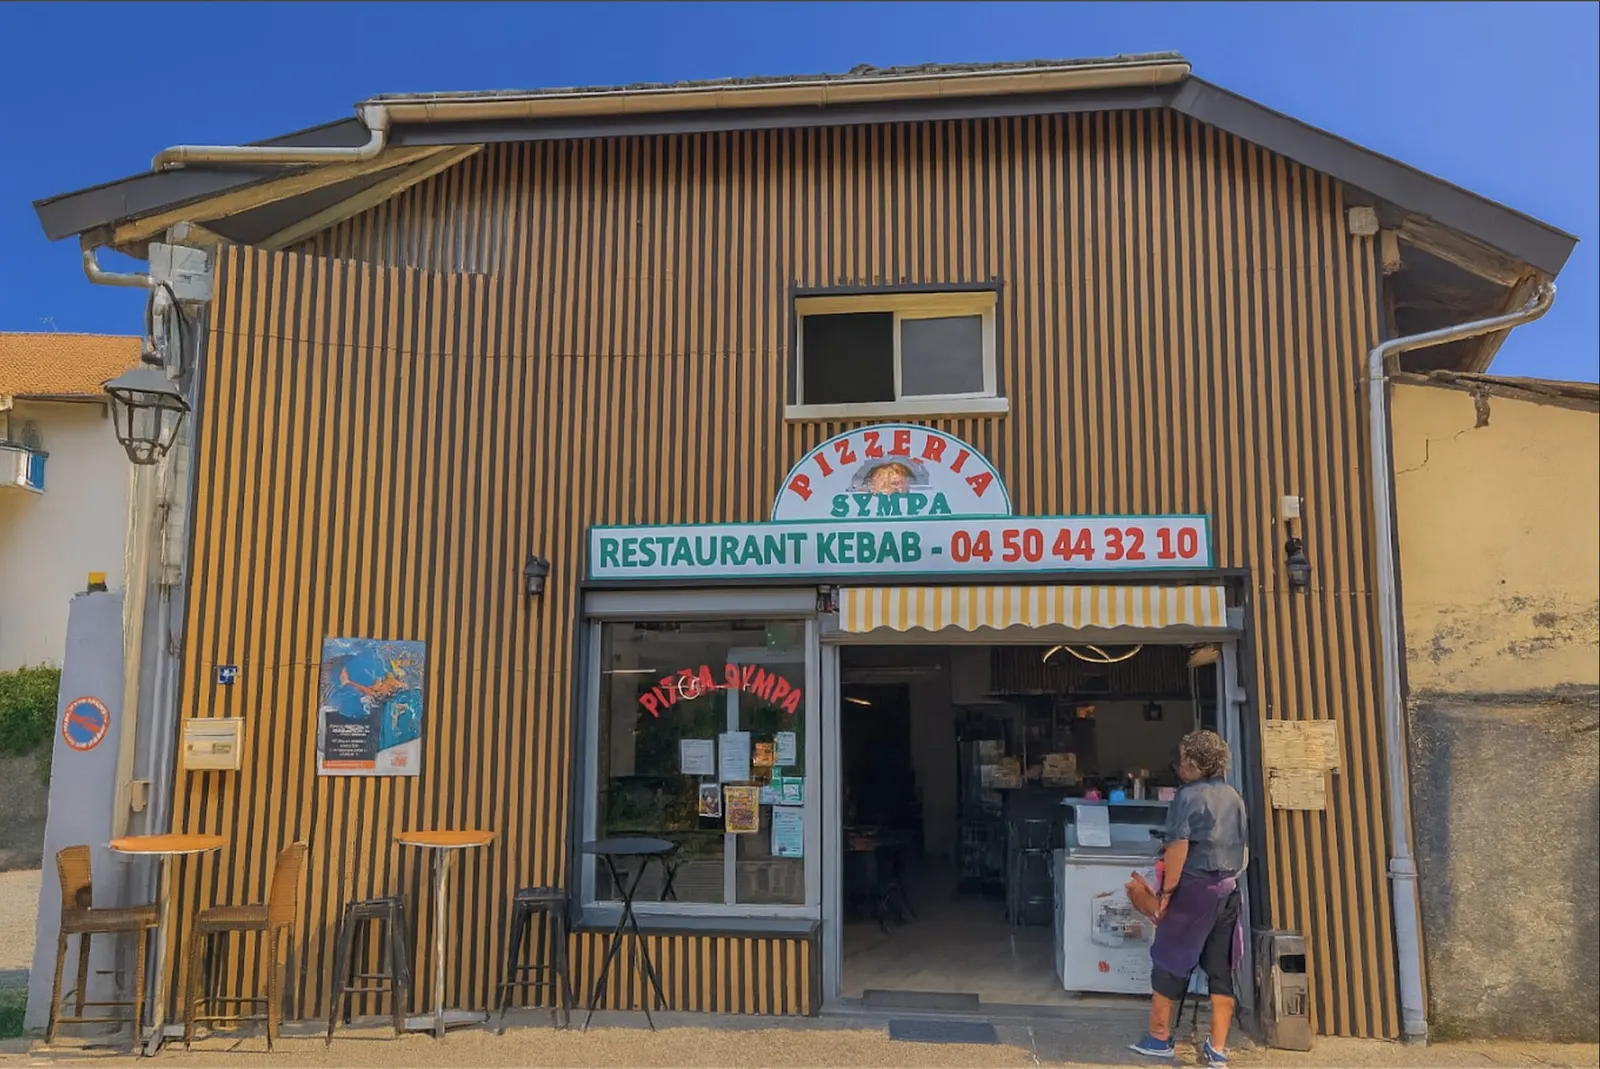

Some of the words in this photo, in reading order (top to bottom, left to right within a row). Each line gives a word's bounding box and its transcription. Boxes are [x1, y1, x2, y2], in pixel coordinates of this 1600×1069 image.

[788, 429, 993, 501] PIZZERIA
[830, 491, 952, 518] SYMPA
[599, 534, 809, 569] RESTAURANT
[816, 530, 922, 566] KEBAB
[951, 530, 993, 562] 04
[1002, 529, 1044, 562] 50
[1052, 528, 1095, 561] 44
[1103, 527, 1145, 560] 32
[1156, 527, 1198, 560] 10
